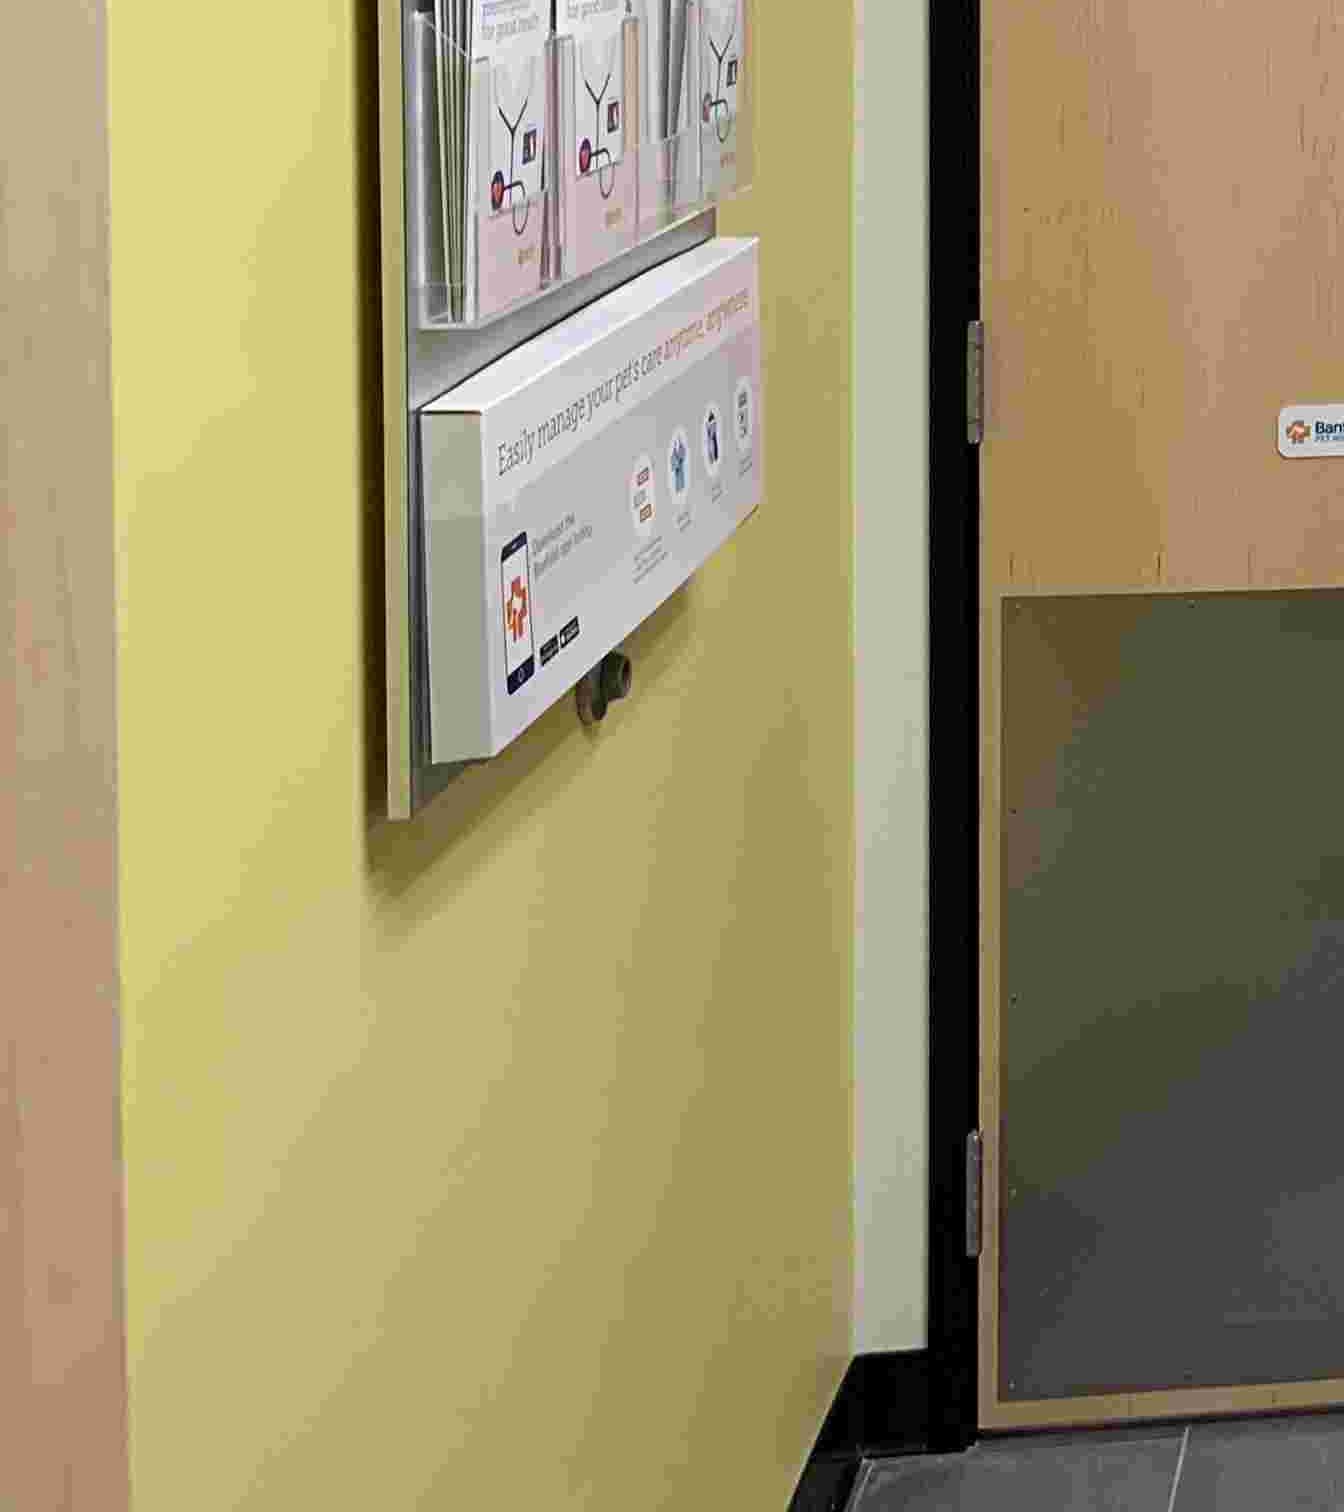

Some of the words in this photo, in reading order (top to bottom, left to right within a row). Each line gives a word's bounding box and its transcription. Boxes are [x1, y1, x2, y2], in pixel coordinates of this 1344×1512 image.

[497, 428, 535, 477] Easily
[537, 397, 585, 449] manage
[586, 378, 614, 424] your
[641, 345, 663, 377] care
